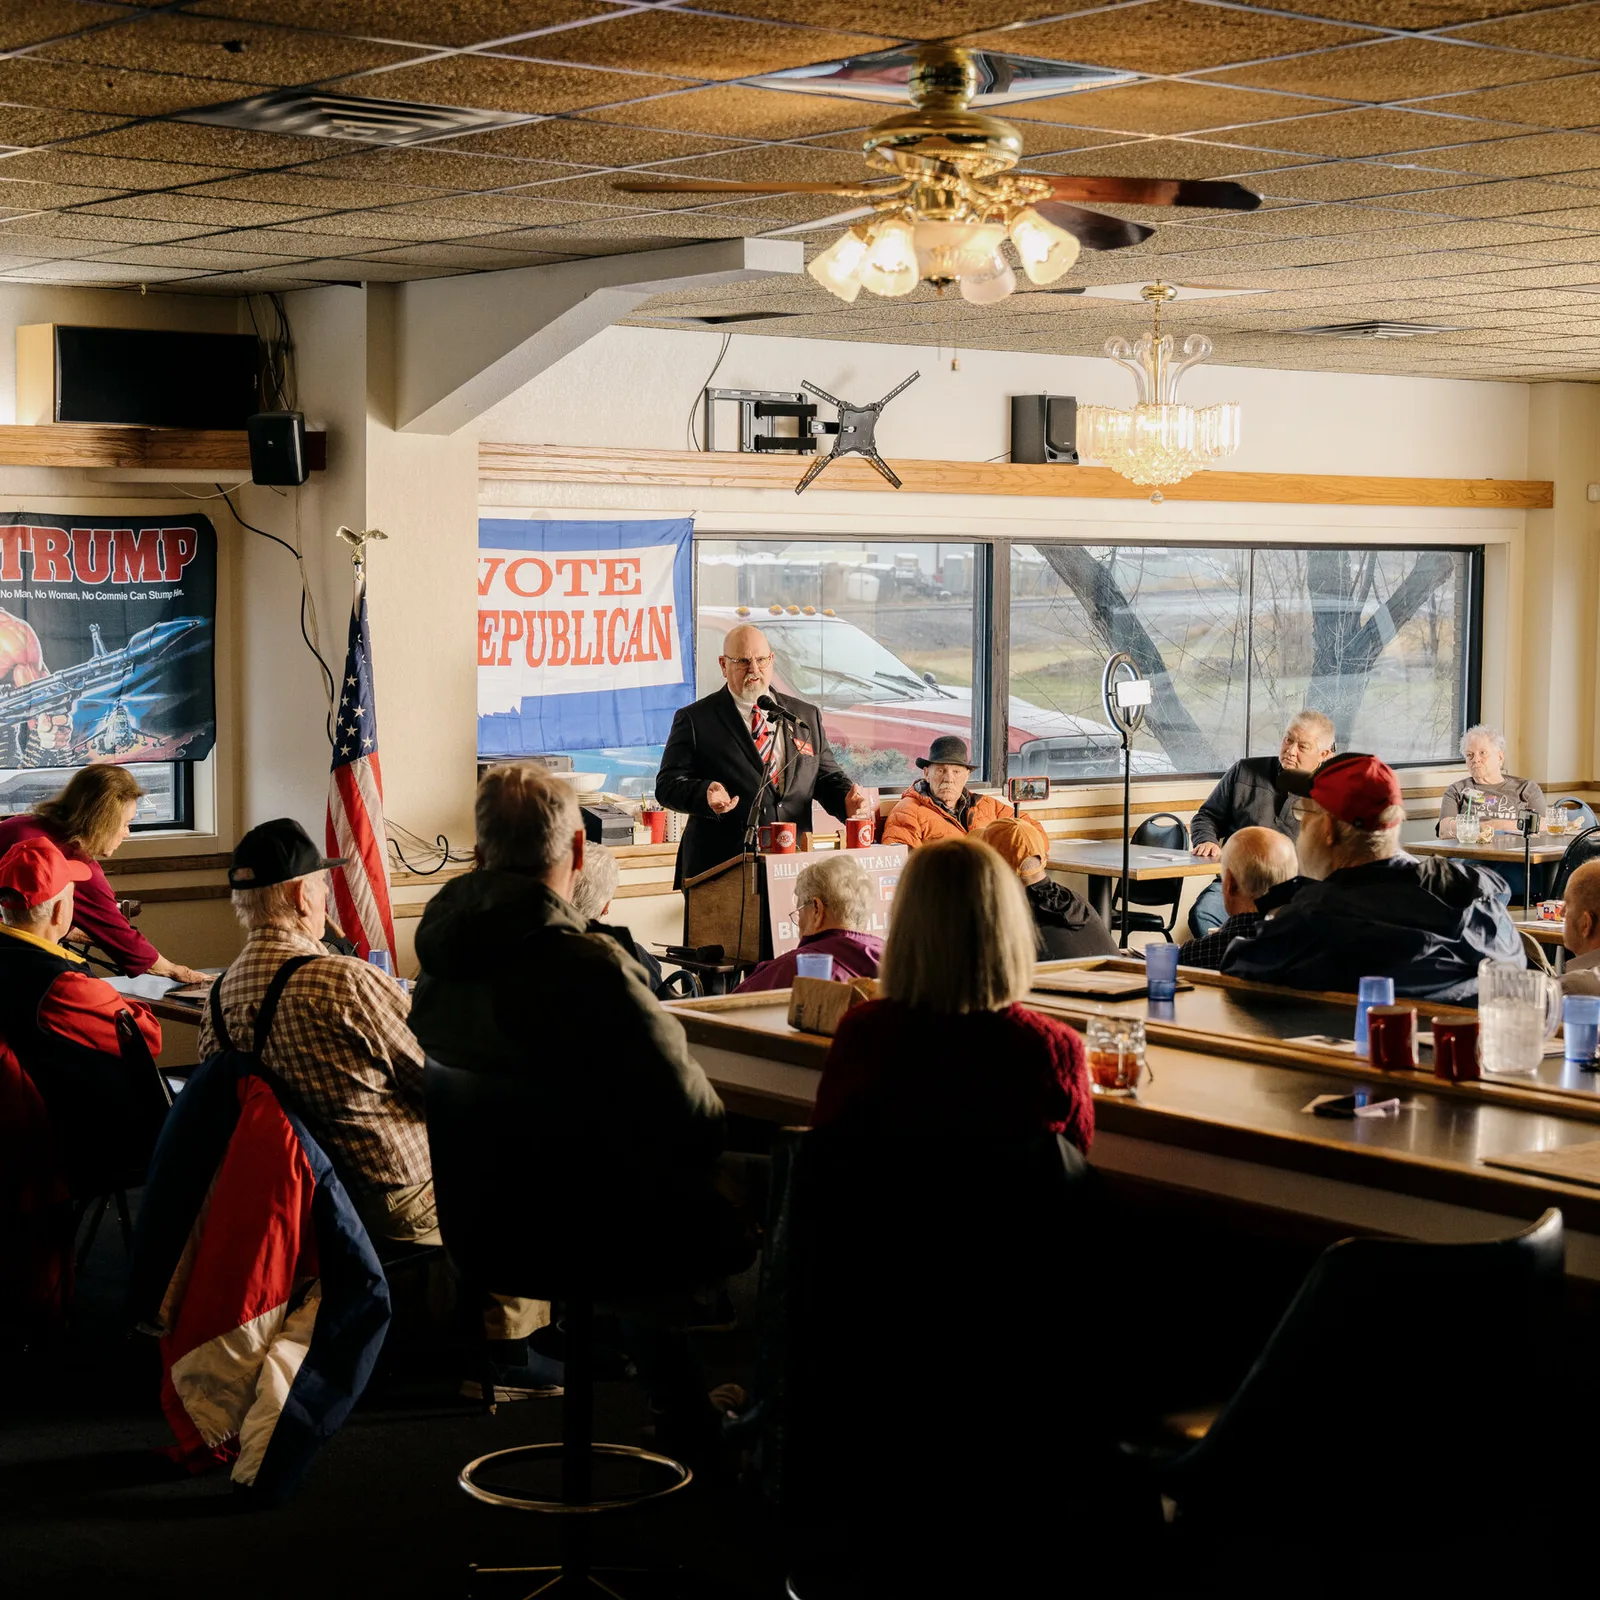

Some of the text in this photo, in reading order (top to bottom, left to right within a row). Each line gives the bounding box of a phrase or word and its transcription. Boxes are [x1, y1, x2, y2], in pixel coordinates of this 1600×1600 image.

[0, 525, 198, 584] TRUMP
[0, 590, 13, 599] No
[14, 589, 34, 600] Man,
[35, 590, 47, 599] No
[48, 590, 80, 601] Woman,
[82, 591, 95, 600] No
[95, 591, 128, 600] Commie
[130, 591, 147, 600] Can
[148, 590, 173, 600] Stump
[477, 557, 643, 598] VOTE
[477, 605, 673, 668] EPUBLICAN
[859, 855, 902, 869] NTANA
